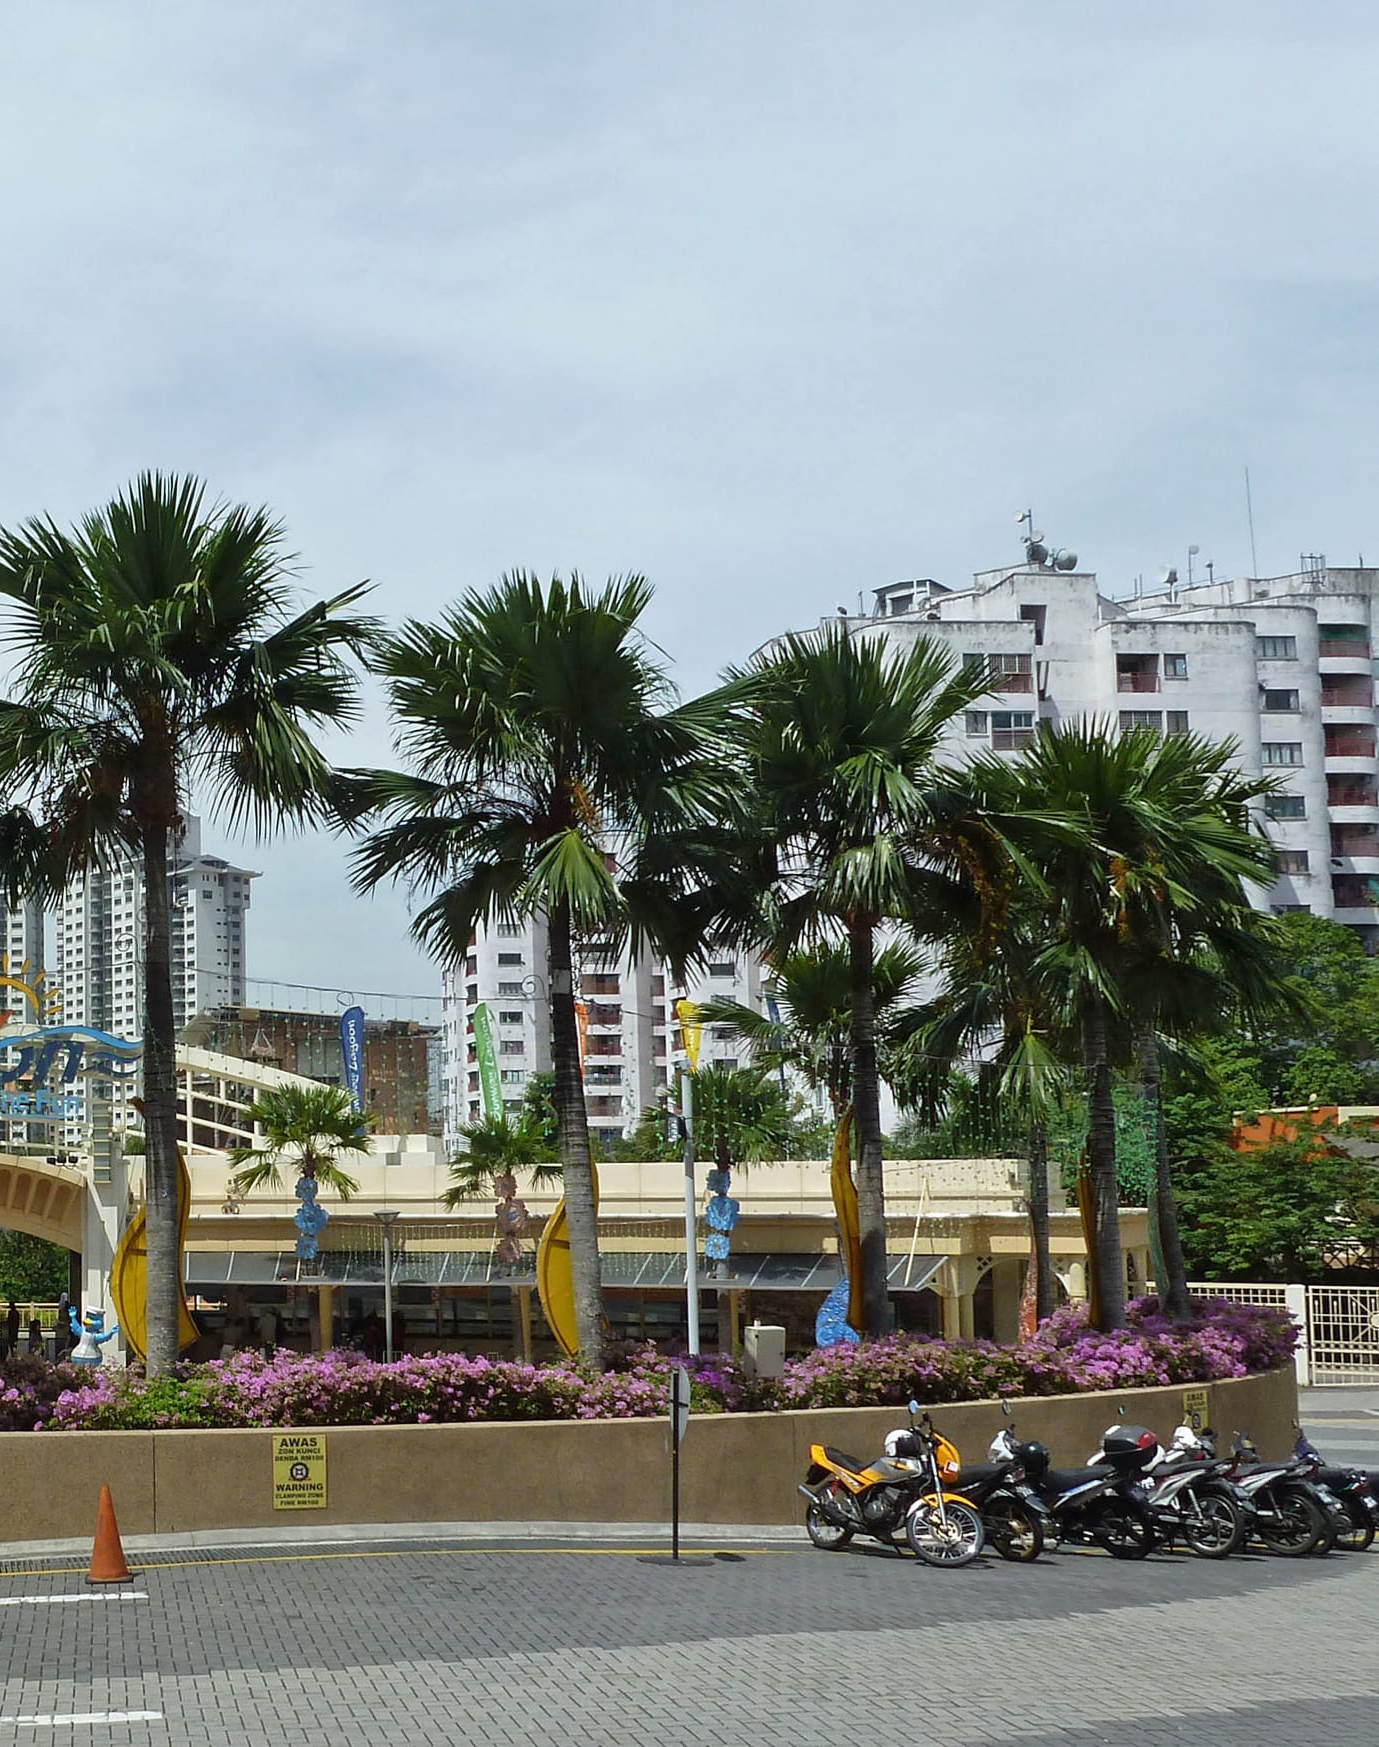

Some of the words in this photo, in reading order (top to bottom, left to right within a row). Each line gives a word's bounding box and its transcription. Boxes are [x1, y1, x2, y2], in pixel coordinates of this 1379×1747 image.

[348, 1020, 359, 1071] Lagoon
[36, 1088, 81, 1113] Fun
[280, 1437, 318, 1447] AWAS
[276, 1483, 324, 1492] WARNING
